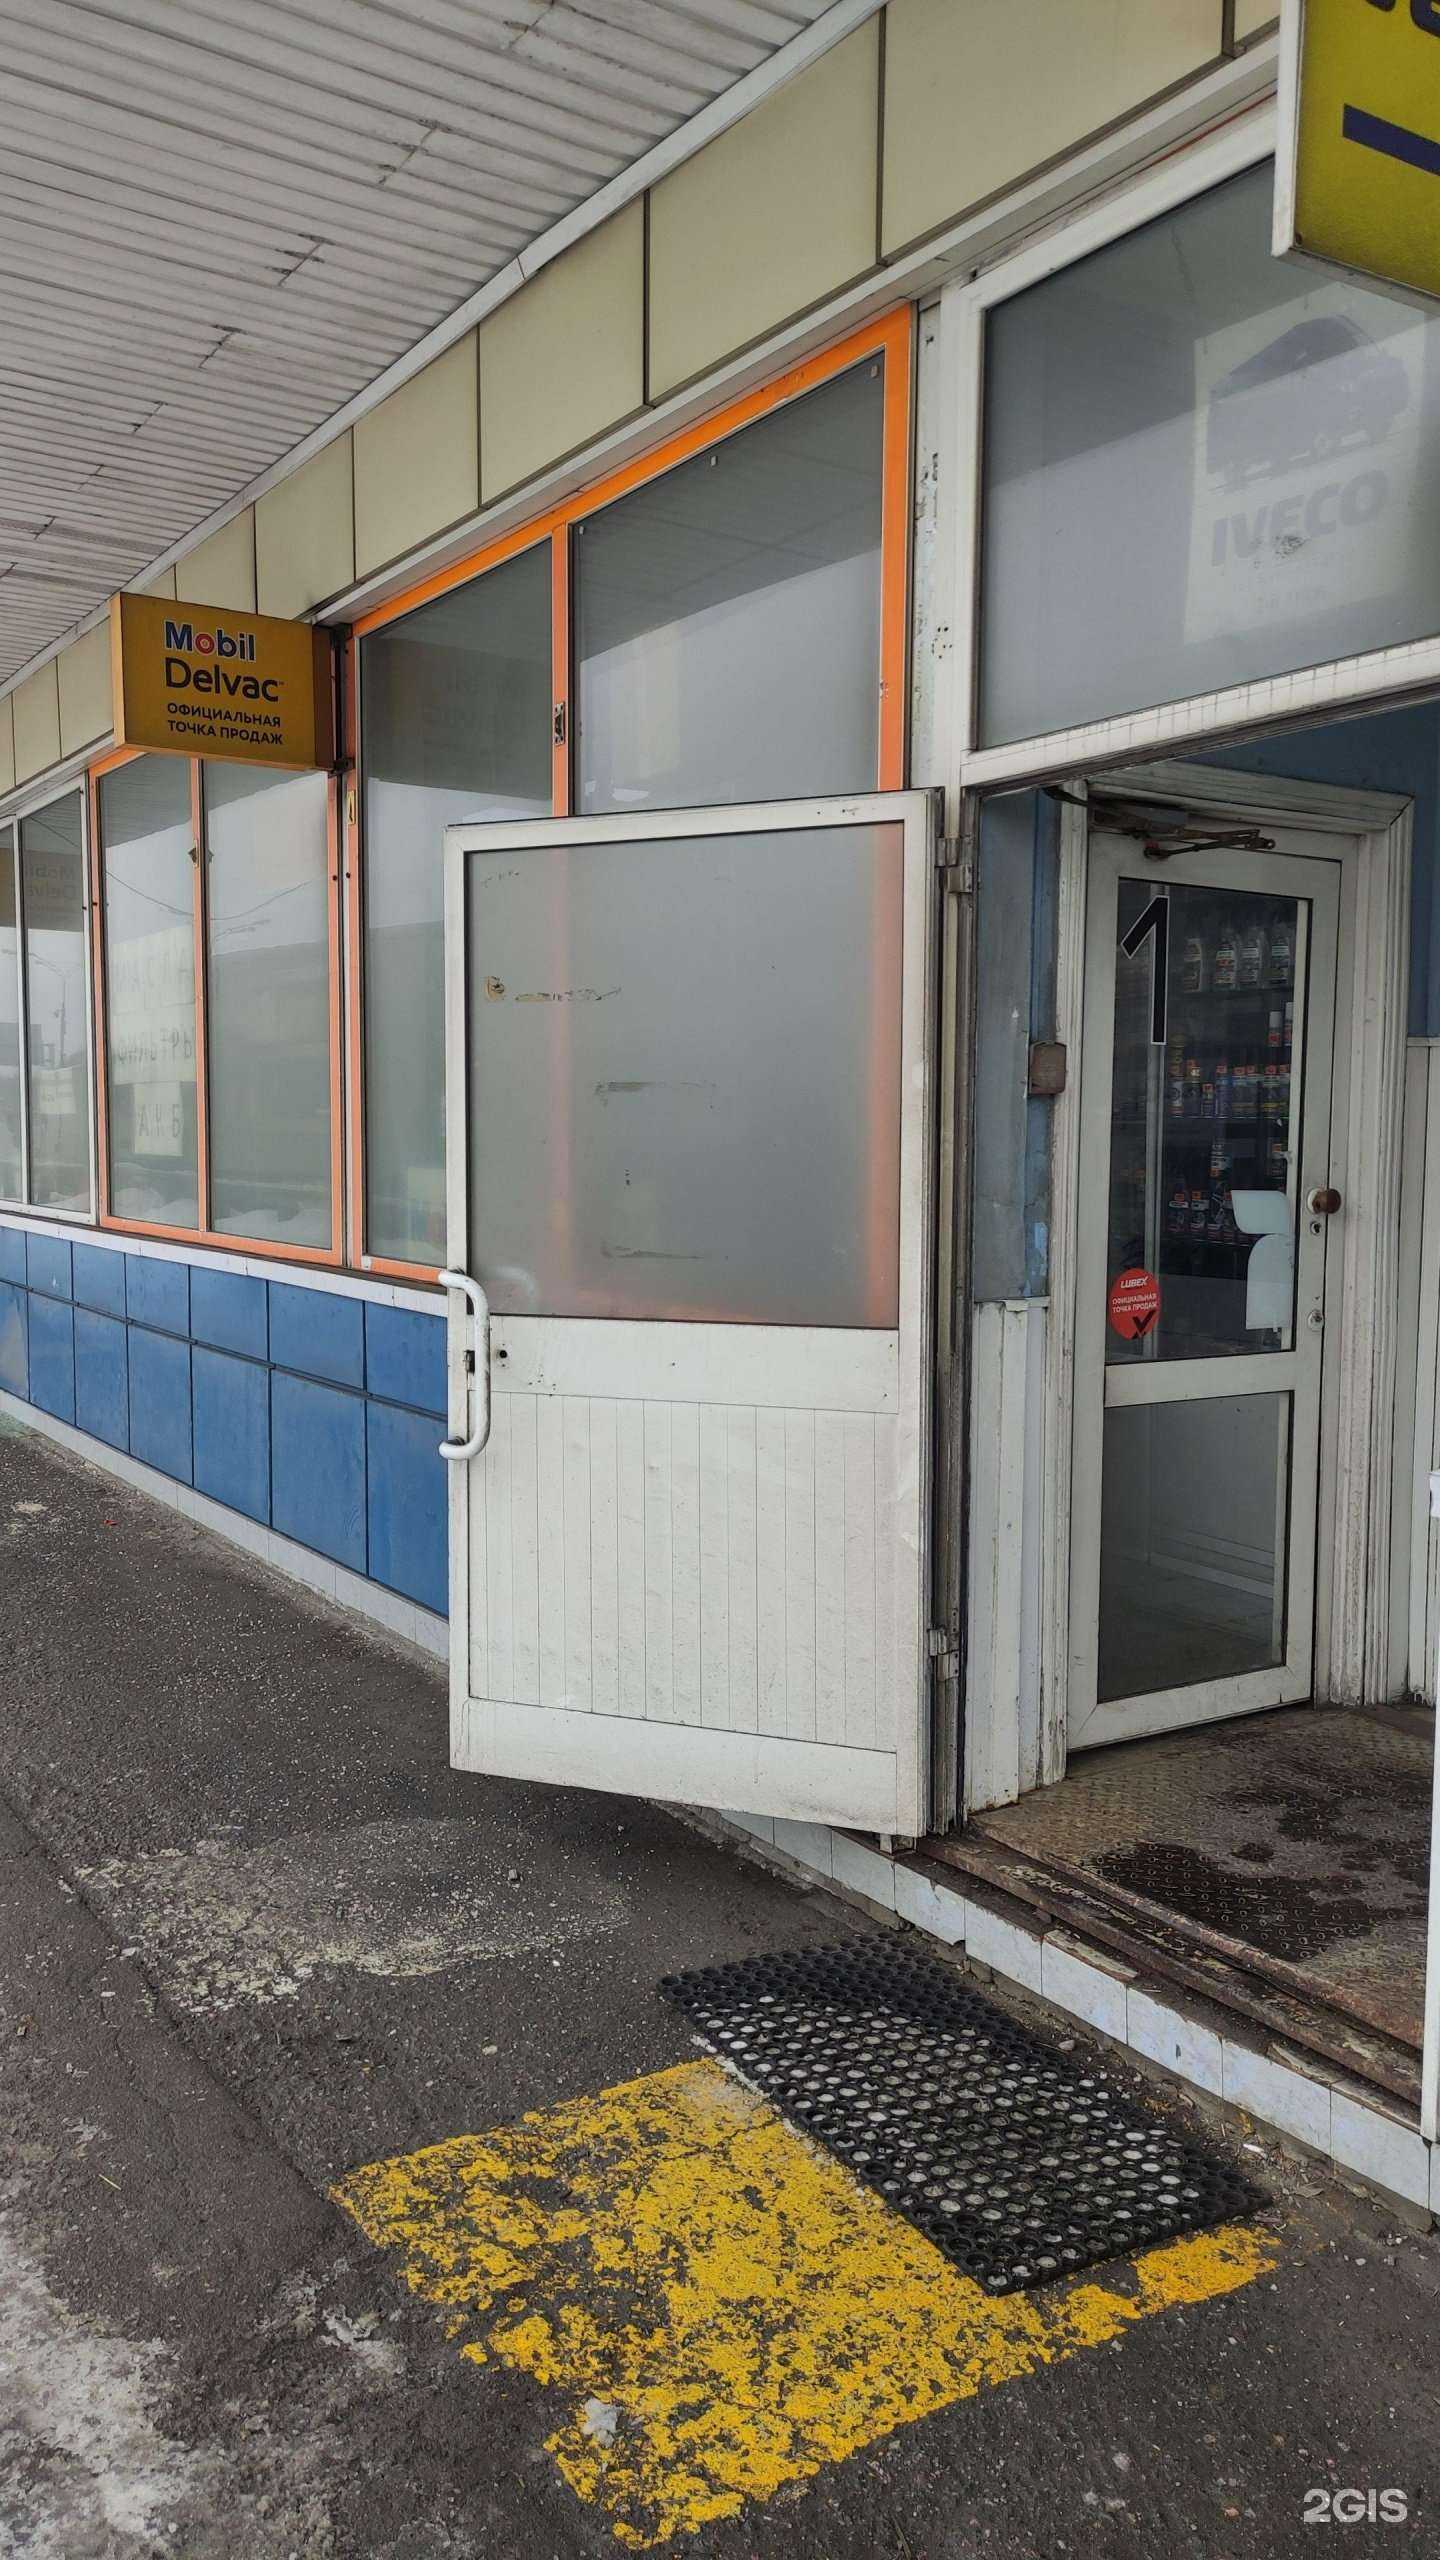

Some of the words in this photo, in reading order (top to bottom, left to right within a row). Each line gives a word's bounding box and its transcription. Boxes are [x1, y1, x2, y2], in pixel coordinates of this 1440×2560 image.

[1211, 469, 1389, 567] IVECO
[164, 619, 256, 663] Mobil
[165, 657, 279, 702] Delvac
[167, 702, 281, 727] ОФИЦИАЛЬНАЯ
[167, 719, 217, 737] ТОЧКА
[220, 726, 284, 745] ПРОДАЖ
[1120, 895, 1169, 1045] 1
[138, 1102, 182, 1138] АКБ
[1120, 1276, 1148, 1289] LUBEX
[1112, 1293, 1157, 1305] ОФИЦИАЛЬНАЯ
[1113, 1304, 1132, 1313] ТОЧКА
[1132, 1301, 1158, 1312] ПРОДАЖ
